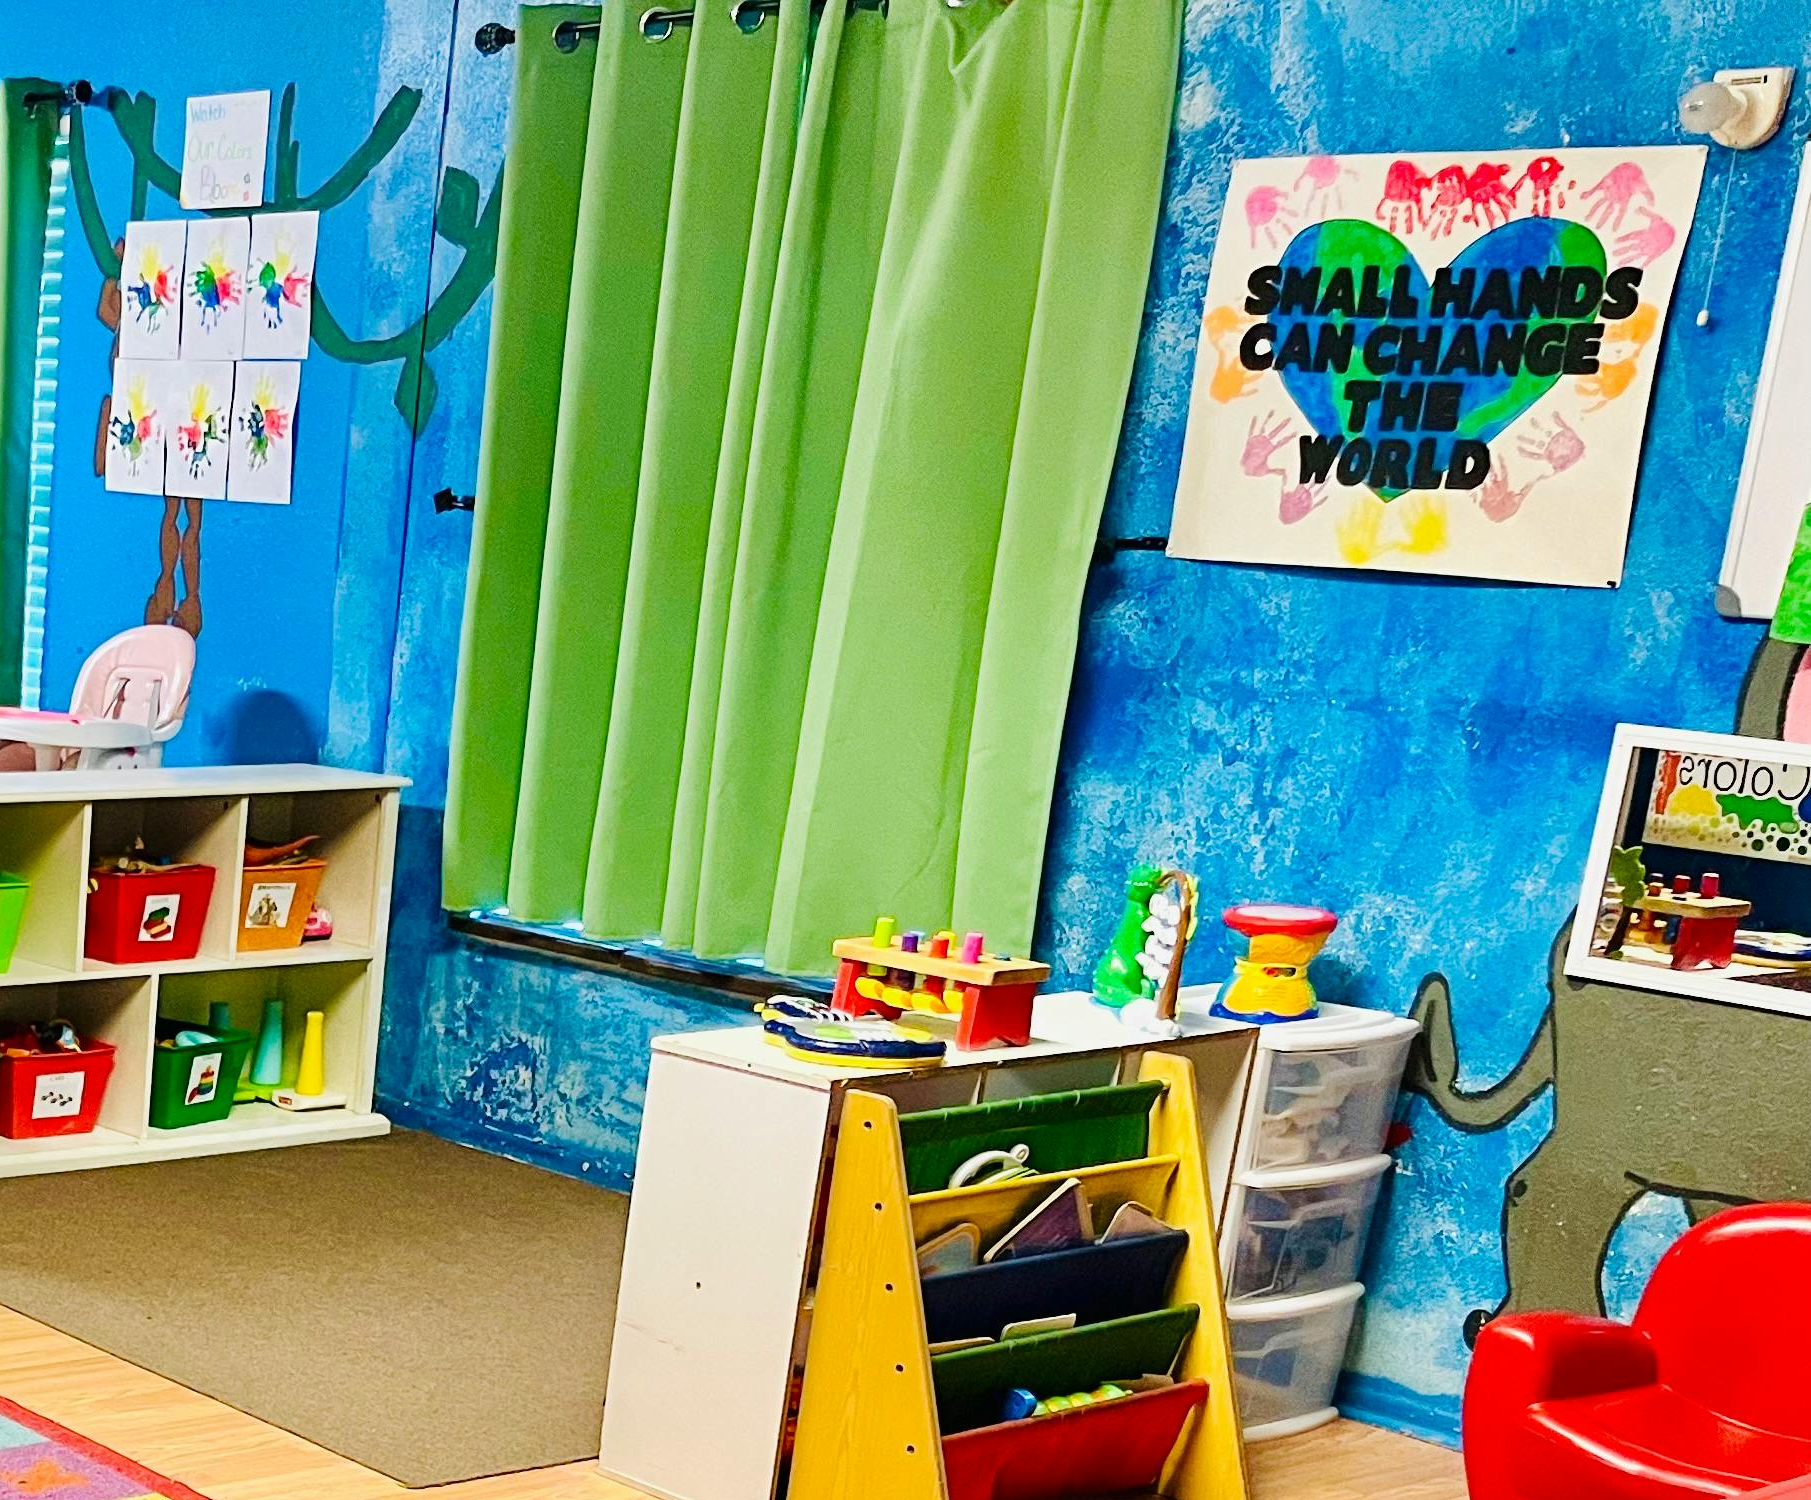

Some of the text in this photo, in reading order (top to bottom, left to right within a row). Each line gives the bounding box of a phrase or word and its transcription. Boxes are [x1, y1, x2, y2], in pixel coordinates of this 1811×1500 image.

[1244, 264, 1643, 320] SMALL HANDS
[1240, 322, 1604, 377] CAN CHANGE
[1344, 380, 1464, 433] THE
[1299, 435, 1491, 490] WORLD
